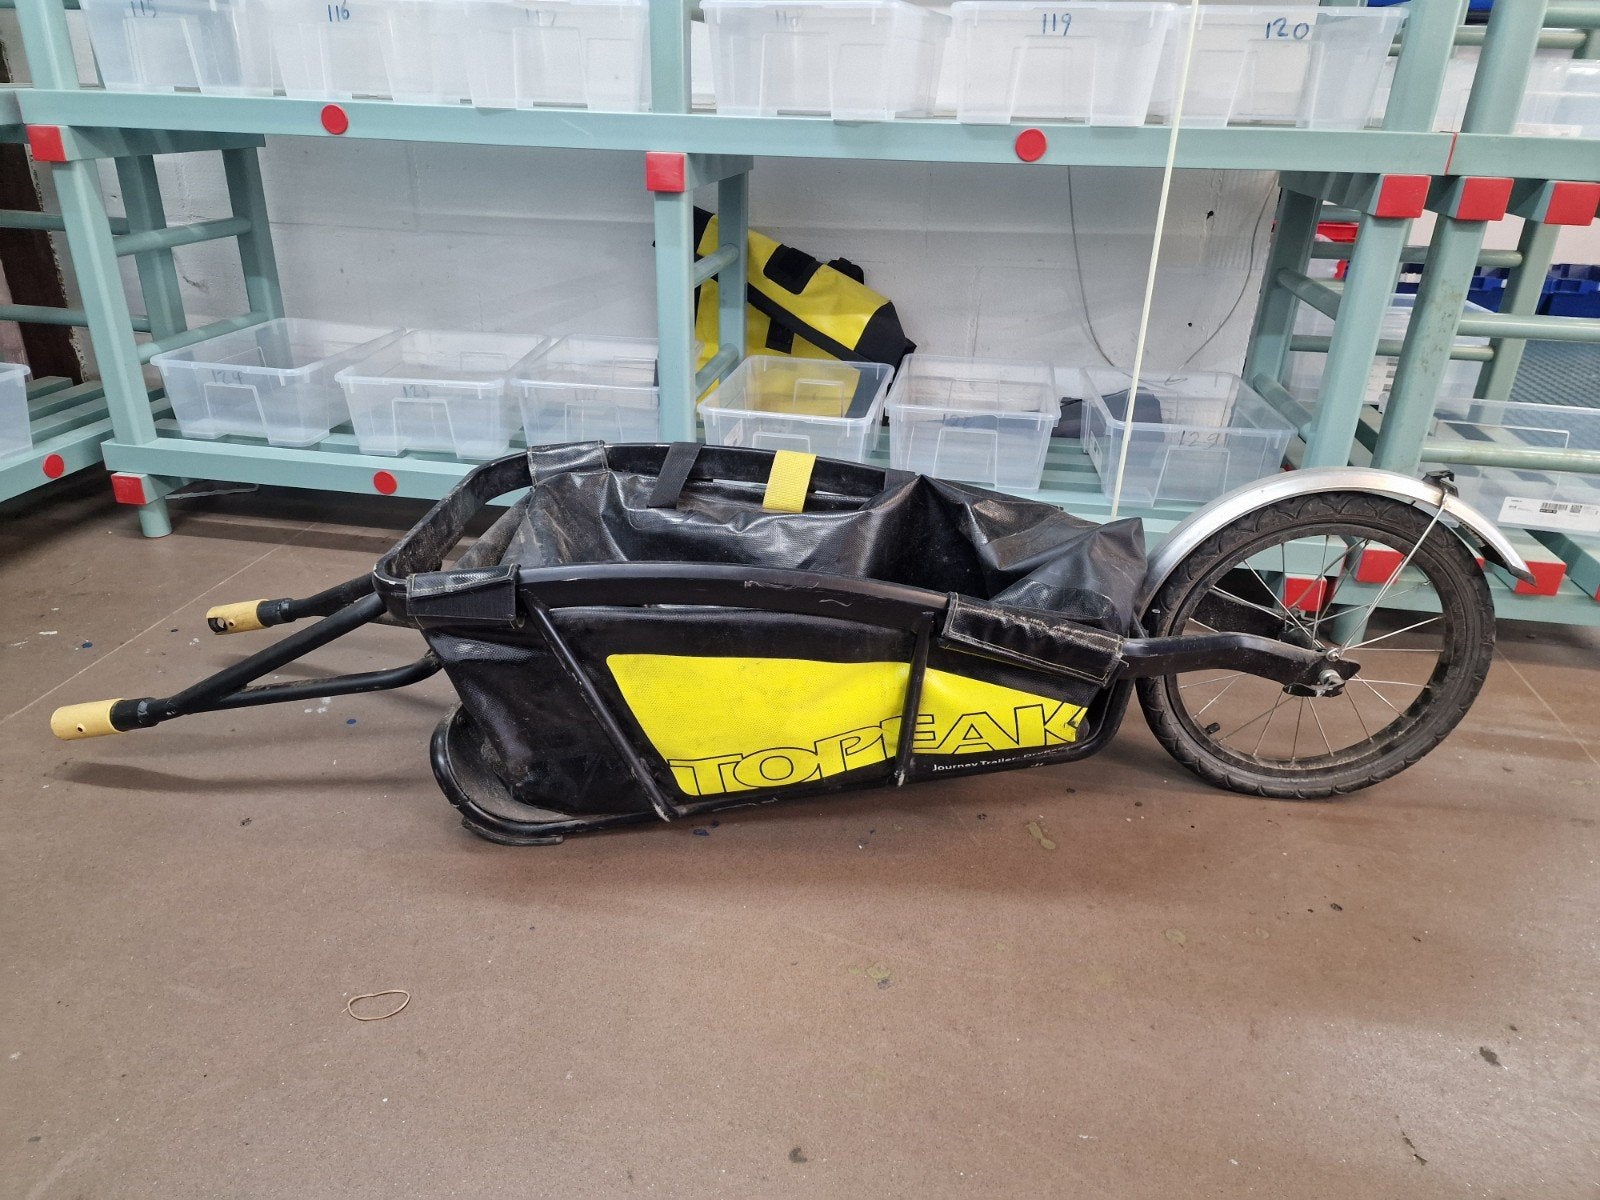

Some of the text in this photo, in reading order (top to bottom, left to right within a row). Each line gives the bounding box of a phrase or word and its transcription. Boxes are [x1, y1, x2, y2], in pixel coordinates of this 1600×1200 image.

[327, 0, 350, 21] 116
[1042, 13, 1072, 36] 119
[1265, 17, 1309, 40] 120
[666, 702, 1083, 795] TOPEAK
[932, 762, 978, 772] Journey
